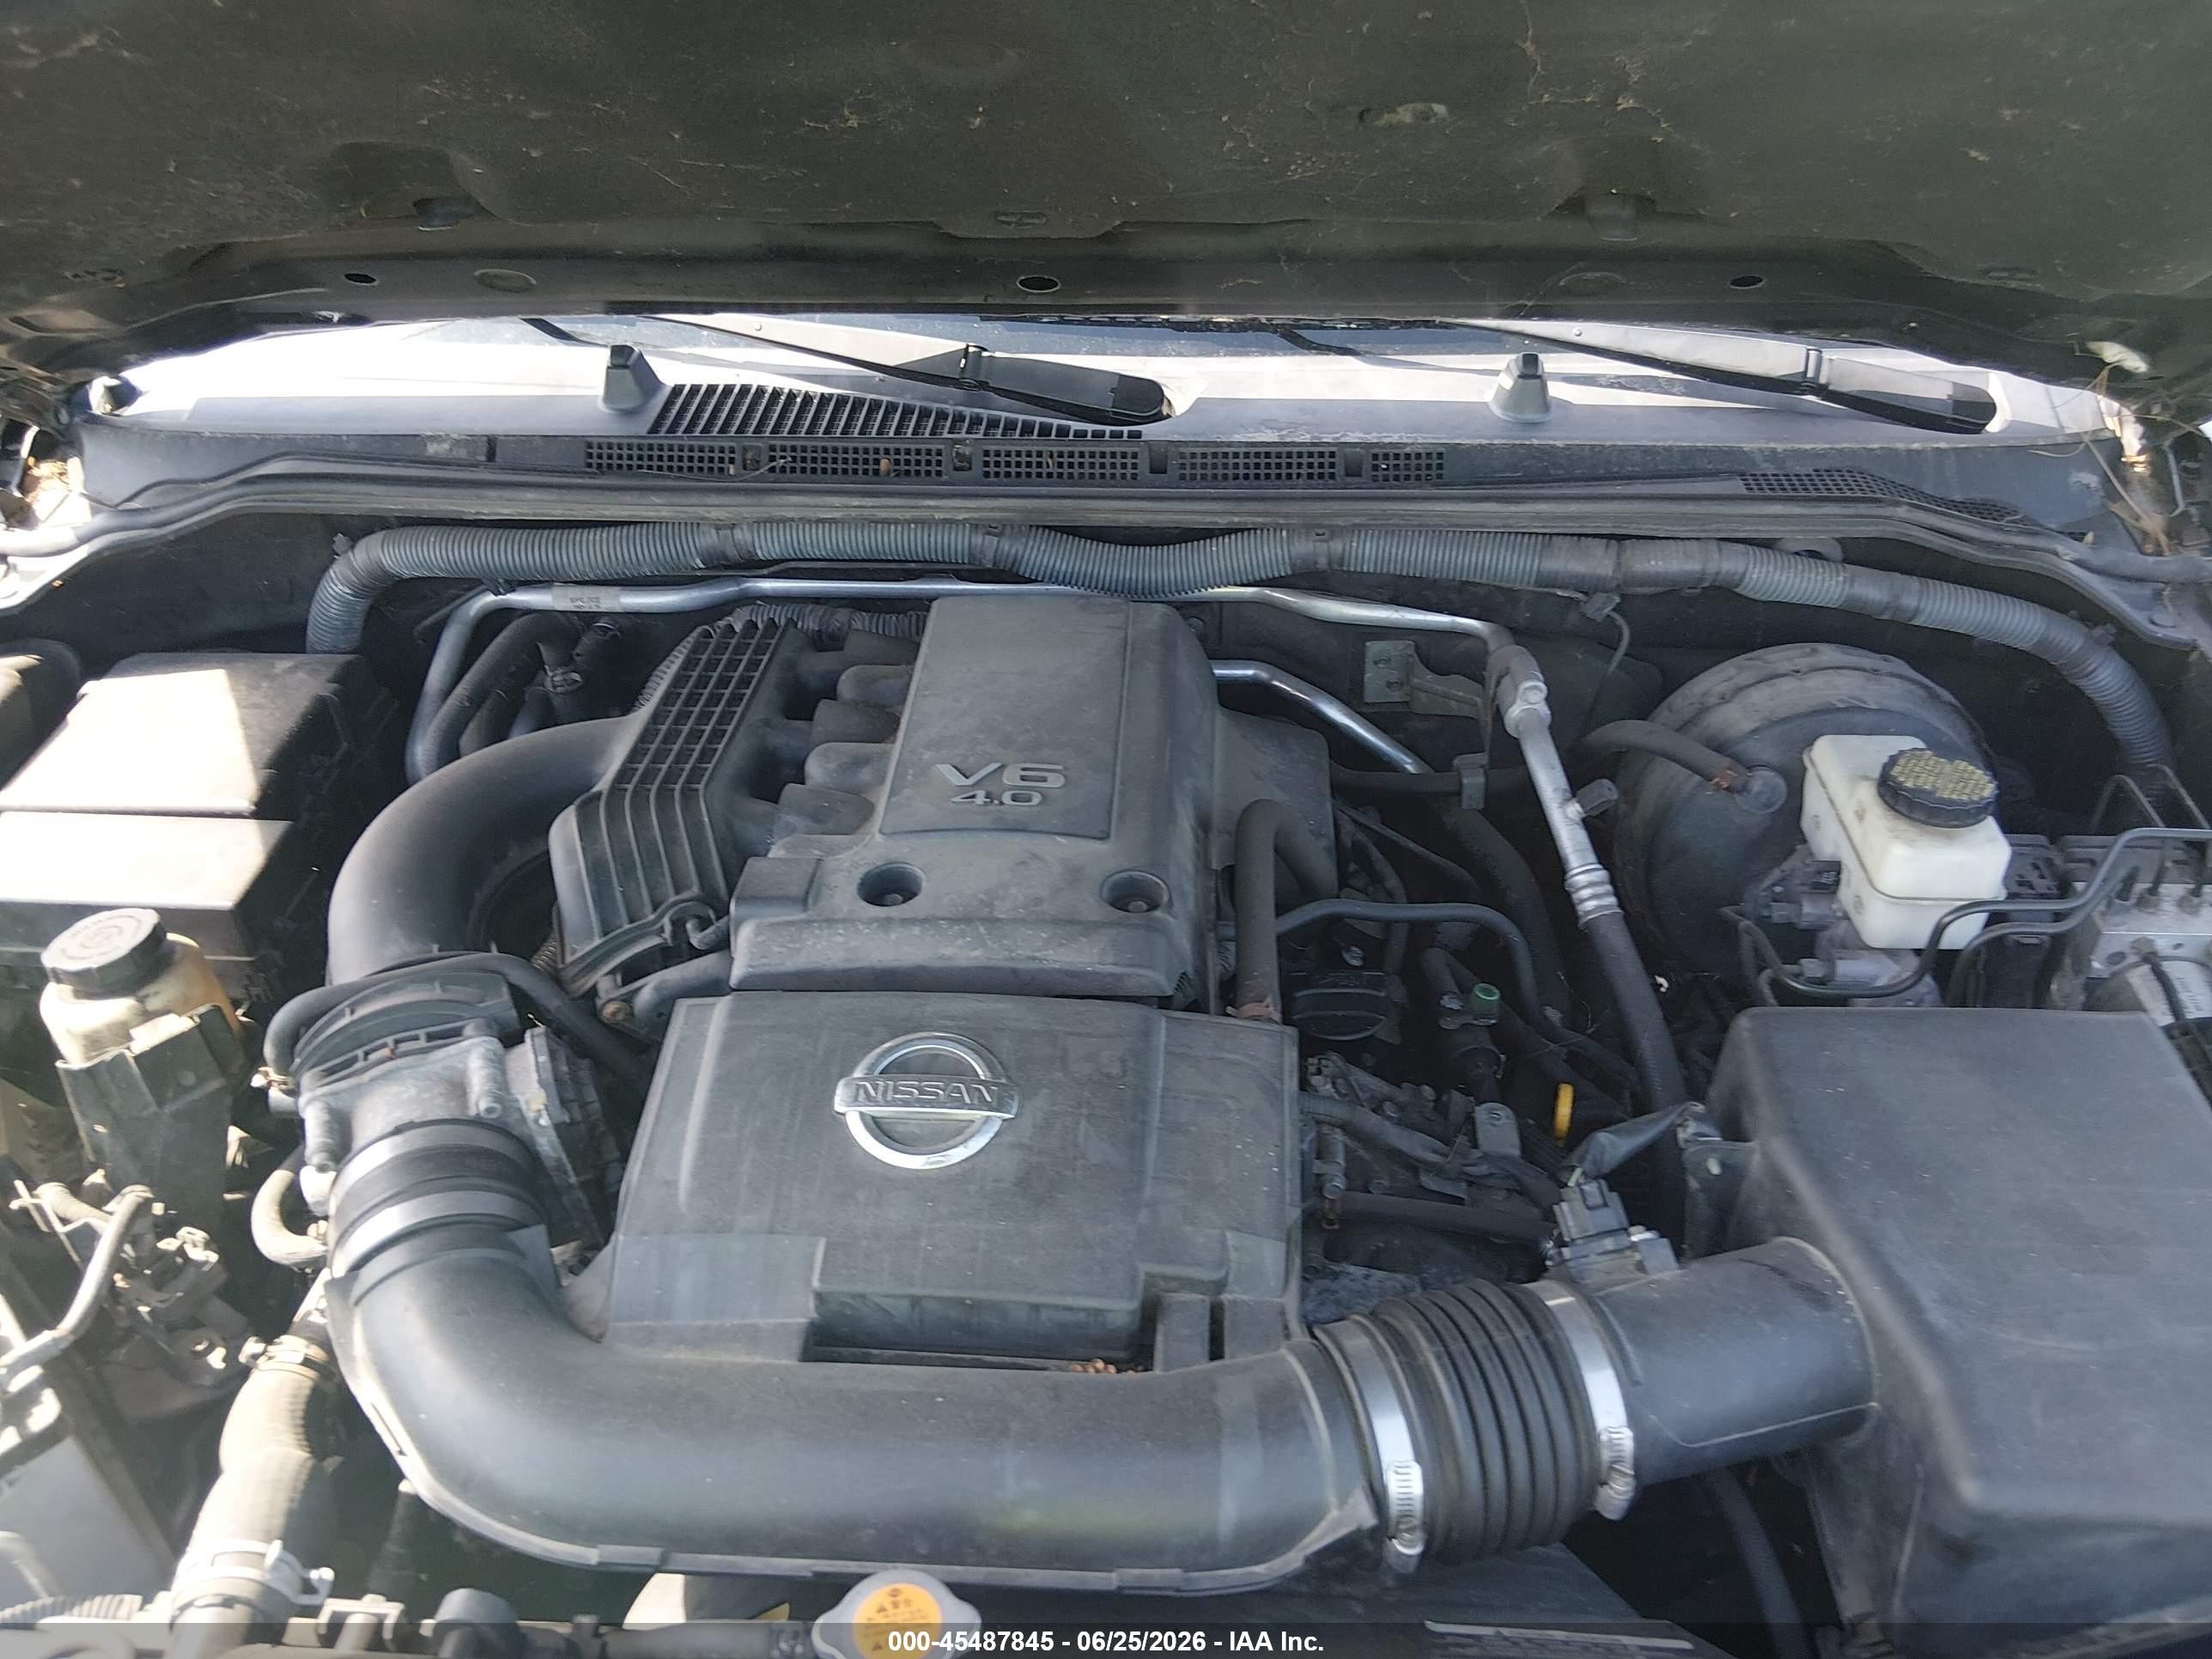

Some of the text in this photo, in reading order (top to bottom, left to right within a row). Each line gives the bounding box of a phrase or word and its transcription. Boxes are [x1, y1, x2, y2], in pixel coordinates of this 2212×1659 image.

[934, 763, 1065, 788] V6
[951, 790, 1043, 805] 4.0
[854, 1080, 999, 1106] NISSAN
